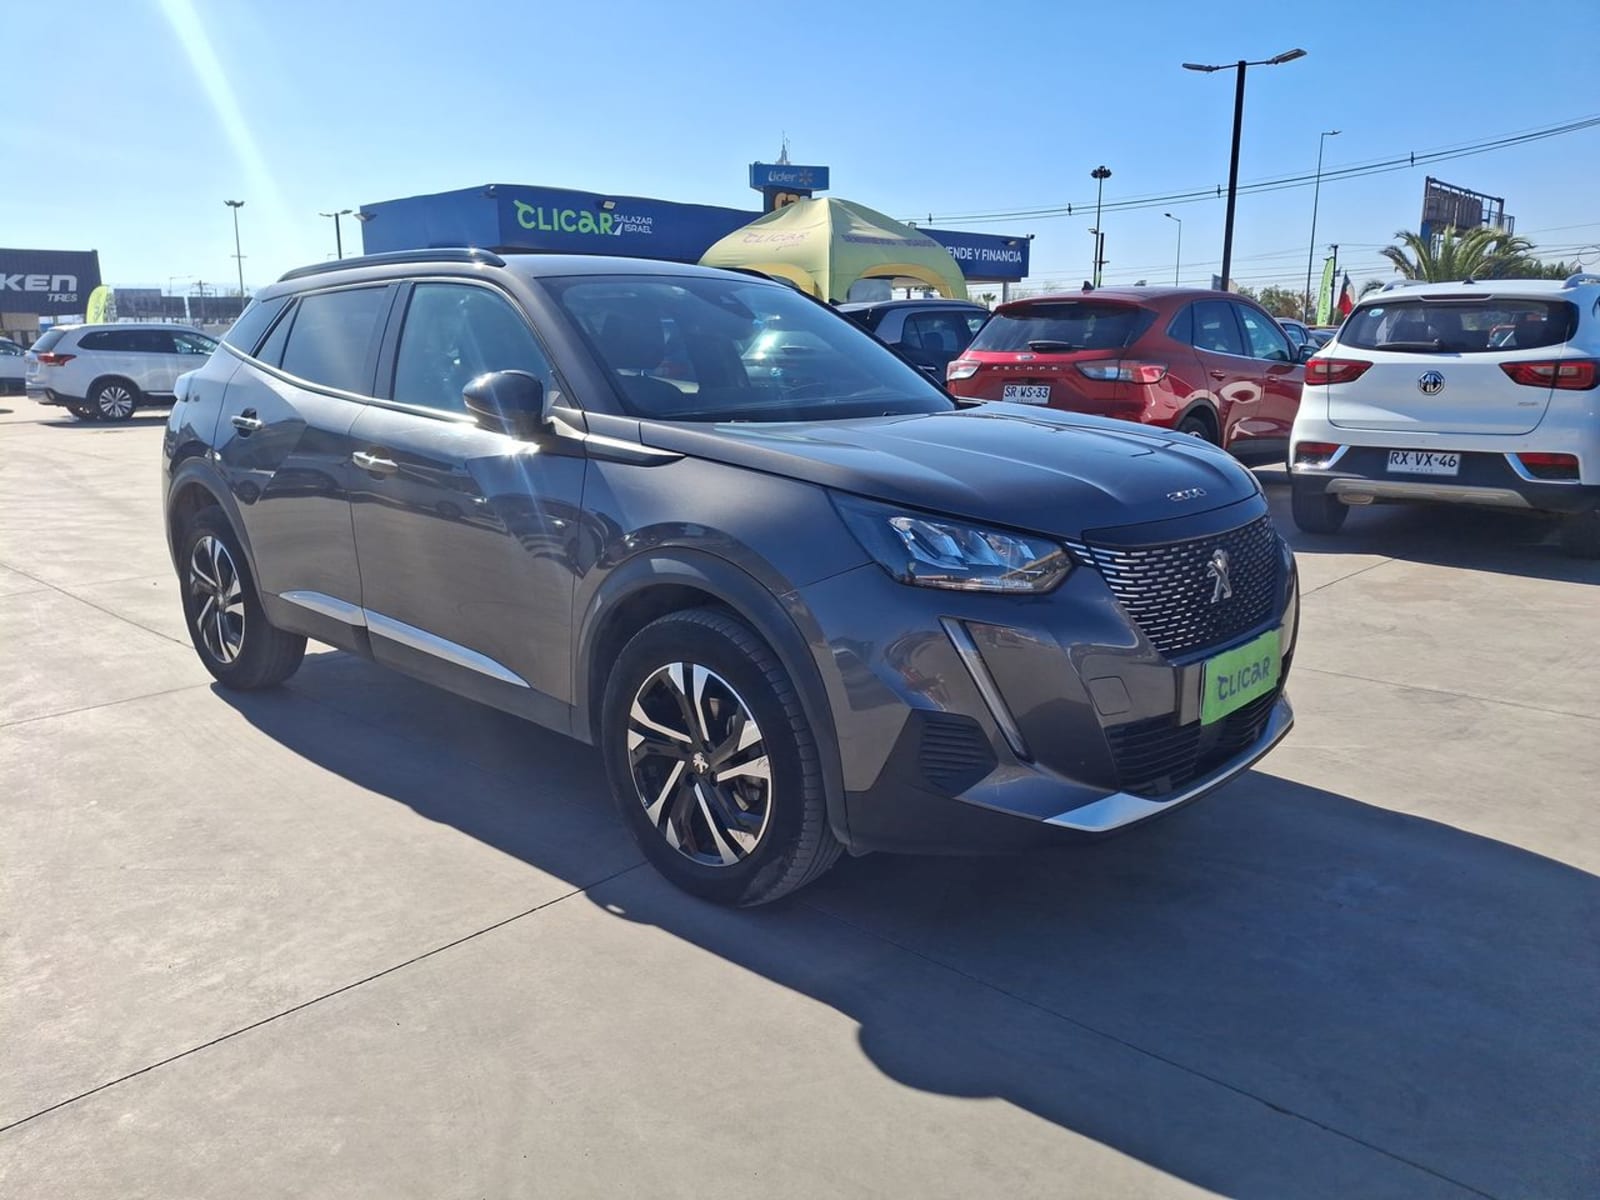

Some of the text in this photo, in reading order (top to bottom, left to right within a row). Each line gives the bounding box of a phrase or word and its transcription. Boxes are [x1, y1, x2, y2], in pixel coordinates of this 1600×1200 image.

[614, 214, 652, 226] SALAZAR
[624, 225, 652, 235] ISRAEL
[945, 246, 1023, 263] ENDE Y FINANCIA
[48, 294, 77, 302] TIRES
